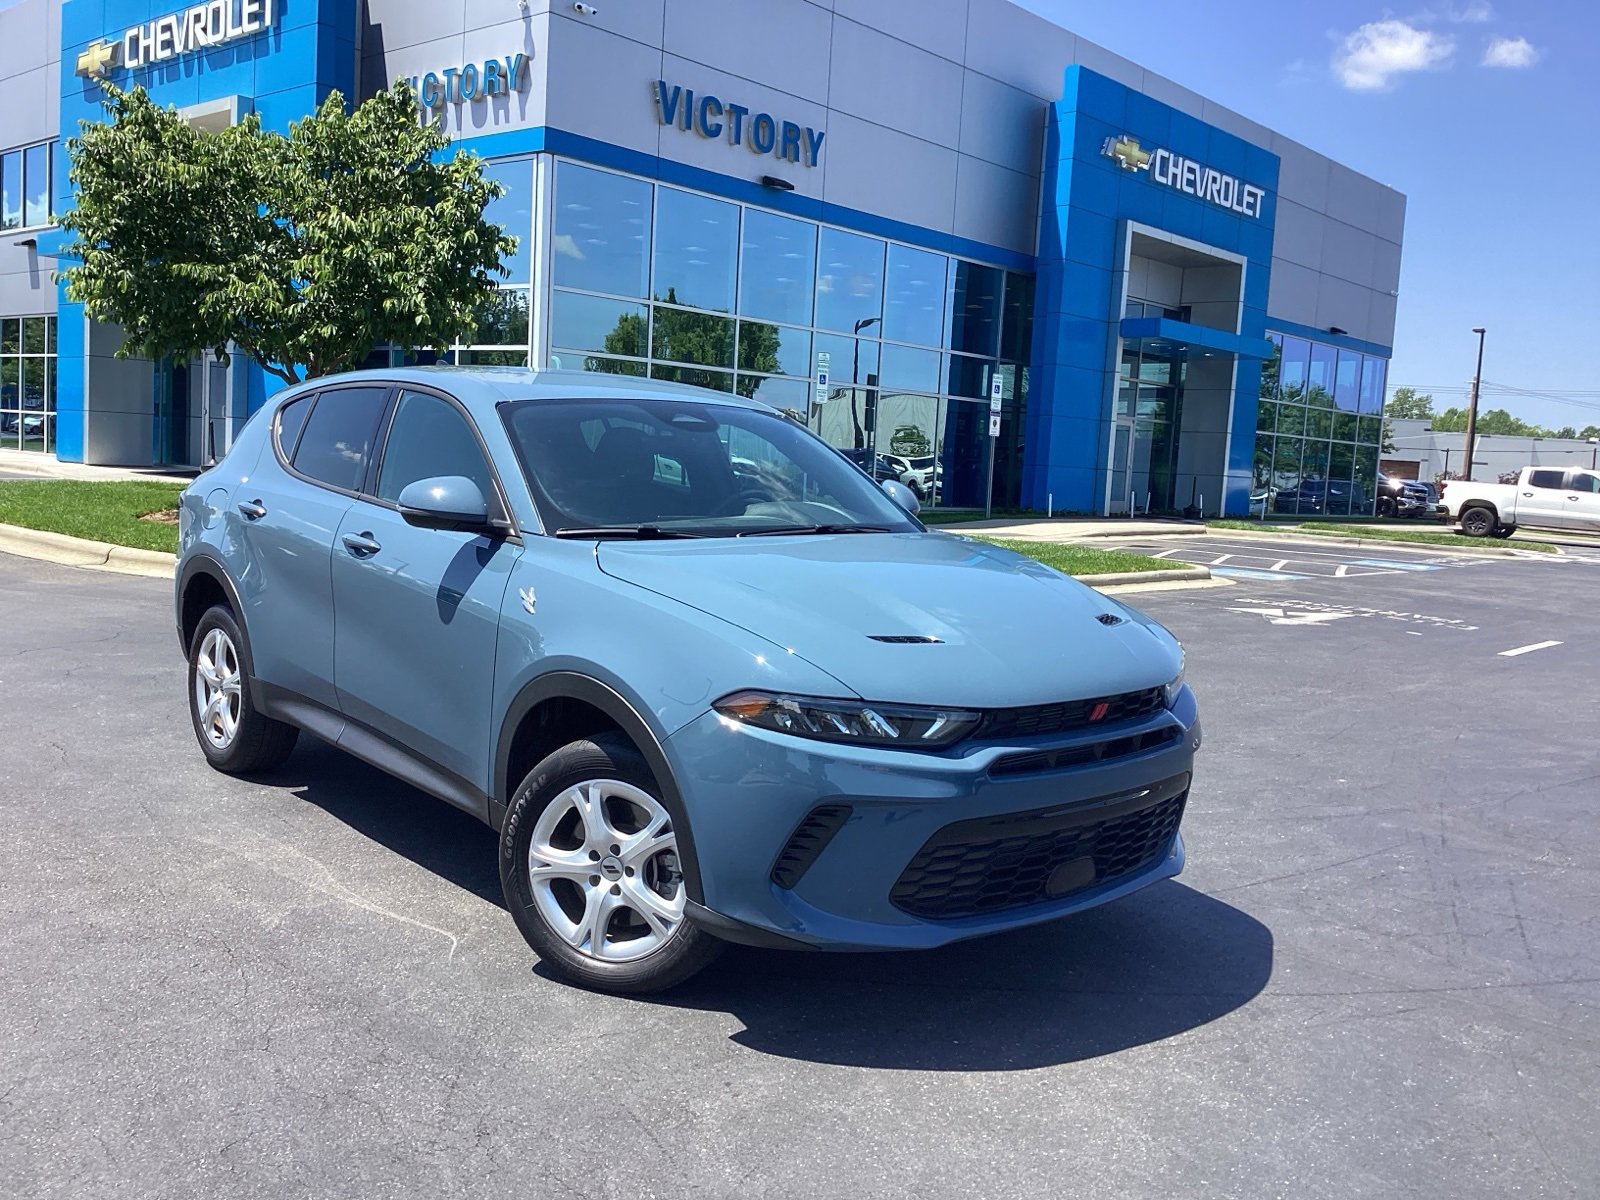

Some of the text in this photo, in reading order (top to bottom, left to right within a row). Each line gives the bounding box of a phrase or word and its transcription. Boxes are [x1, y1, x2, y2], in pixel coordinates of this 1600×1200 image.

[124, 0, 274, 69] CHEVROLET
[404, 54, 527, 108] ICTORY
[653, 80, 825, 168] VICTORY
[1154, 148, 1265, 219] CHEVROLET
[504, 773, 547, 859] GOODYEAR
